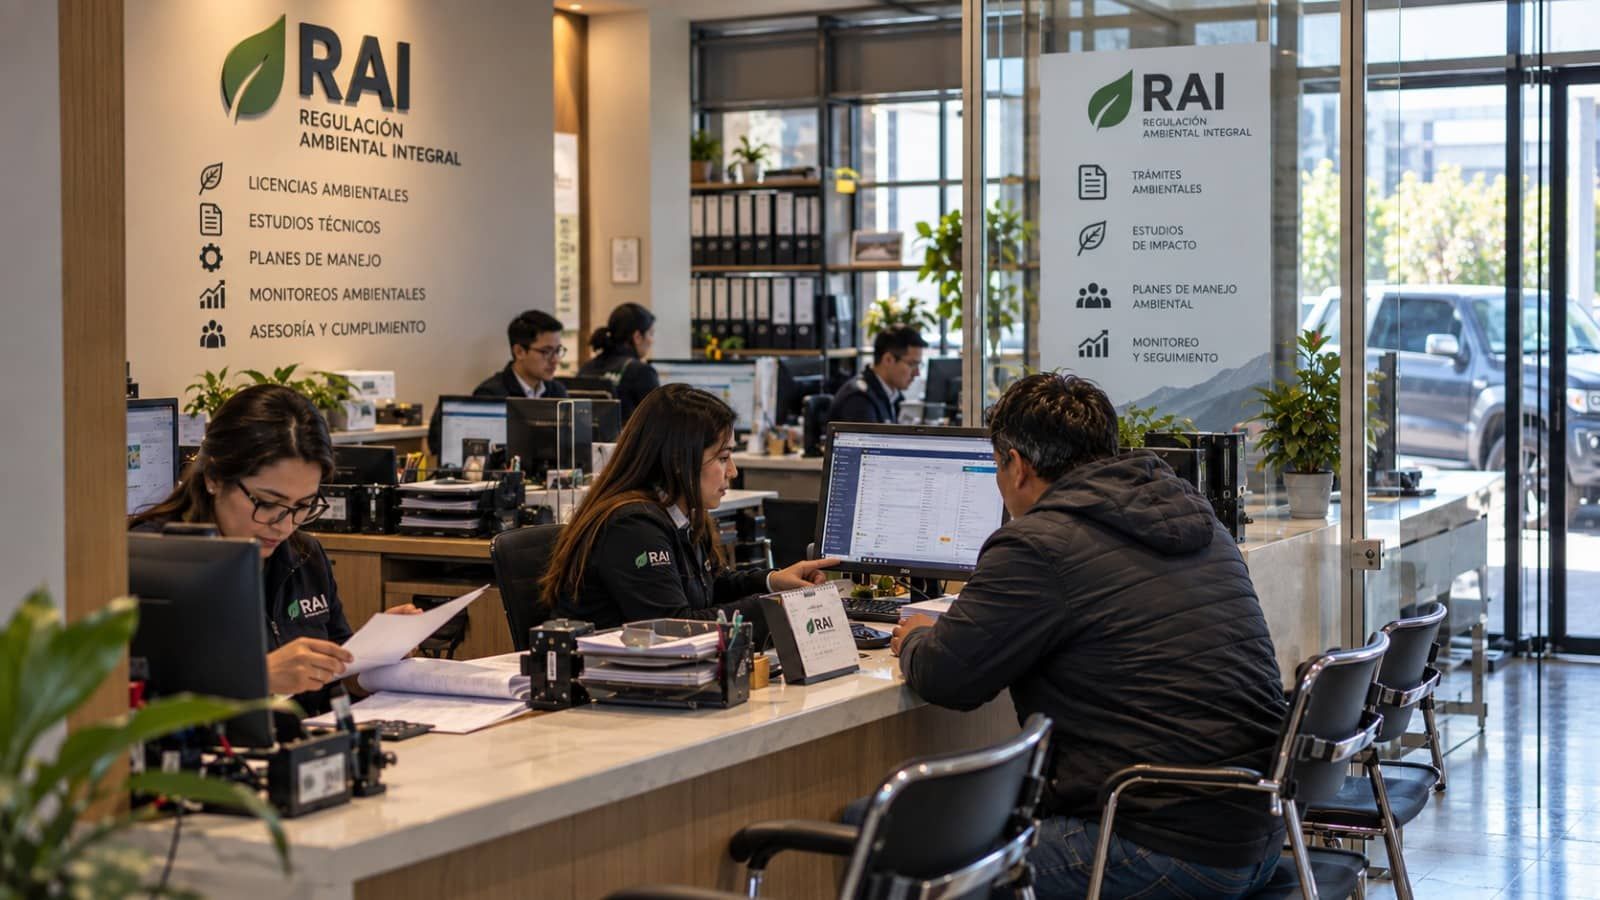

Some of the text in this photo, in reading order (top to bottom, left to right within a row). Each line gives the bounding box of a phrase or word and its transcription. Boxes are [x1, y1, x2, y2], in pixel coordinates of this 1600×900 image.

[299, 22, 411, 113] RAI
[1143, 72, 1225, 112] RAI
[299, 108, 404, 138] REGULACIÓN
[1142, 115, 1208, 127] REGULACIÓN
[1143, 127, 1253, 139] AMBIENTAL INTEGRAL
[299, 132, 462, 166] AMBIENTAL INTEGRAL
[1132, 169, 1182, 180] TRÁMITES
[248, 176, 409, 203] LICENCIAS AMBIENTALES
[1131, 183, 1202, 195] AMBIENTALES
[249, 213, 381, 235] ESTUDIOS TÉCNICOS
[1132, 225, 1184, 236] ESTUDIOS
[1132, 240, 1197, 251] DE IMPACTO
[249, 250, 382, 268] PLANES DE MANEJO
[249, 287, 426, 302] MONITOREOS AMBIENTALES
[1132, 283, 1238, 295] PLANES DE MANEJO
[1132, 298, 1194, 310] AMBIENTAL
[249, 319, 426, 339] ASESORÍA Y CUMPLIMIENTO
[1132, 337, 1200, 348] MONITOREO
[1132, 352, 1219, 363] Y SEGUIMIENTO
[648, 551, 670, 563] RAI
[299, 594, 328, 614] RAI
[814, 616, 834, 631] RAI
